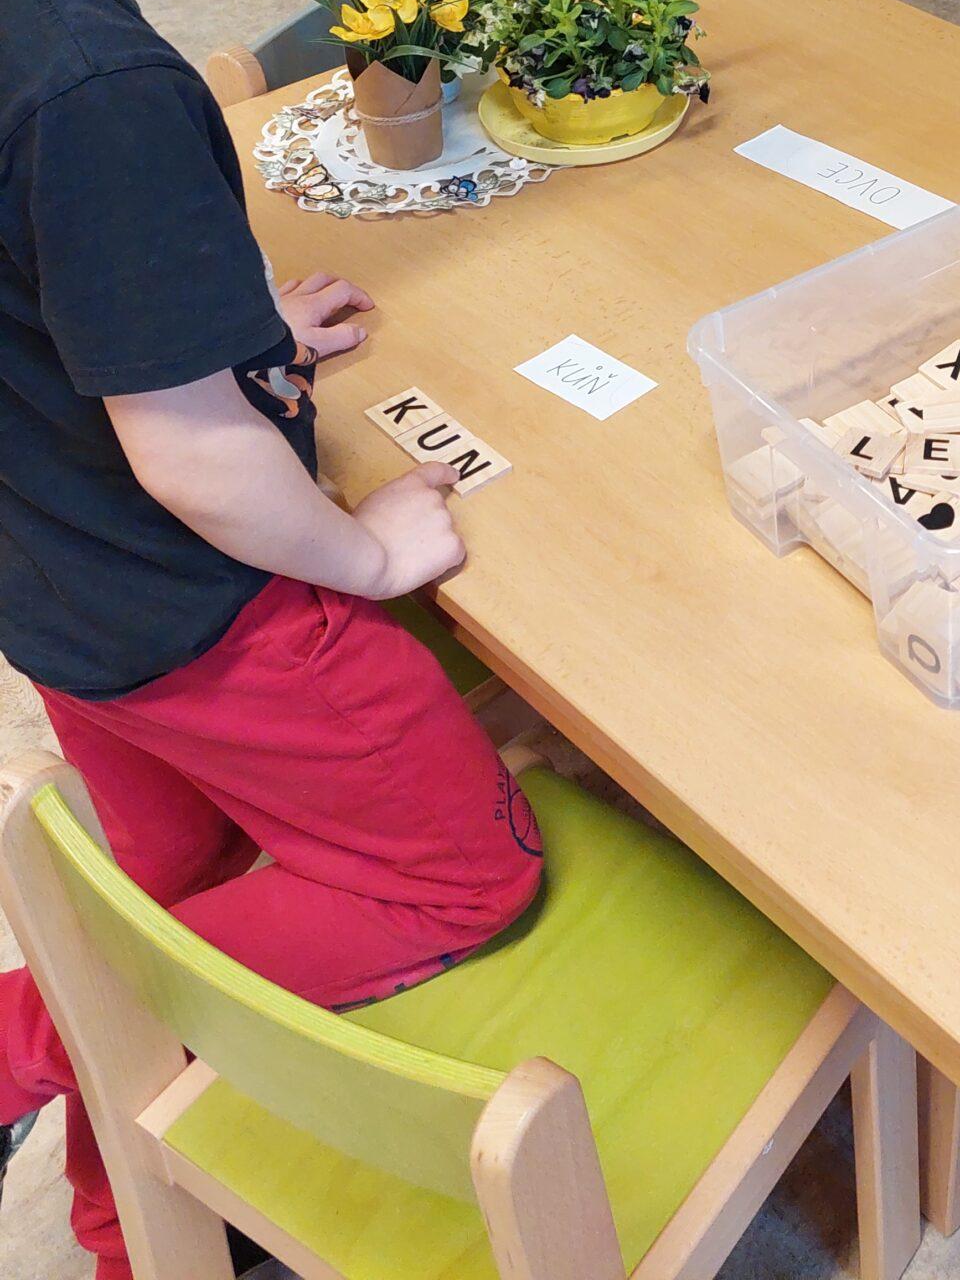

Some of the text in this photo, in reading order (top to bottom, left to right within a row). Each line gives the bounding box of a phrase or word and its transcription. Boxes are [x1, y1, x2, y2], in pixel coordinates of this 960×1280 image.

[817, 162, 901, 204] OVCE
[546, 358, 618, 395] KŮŇ
[382, 396, 493, 482] KUN
[850, 436, 874, 461] L
[923, 438, 950, 462] E
